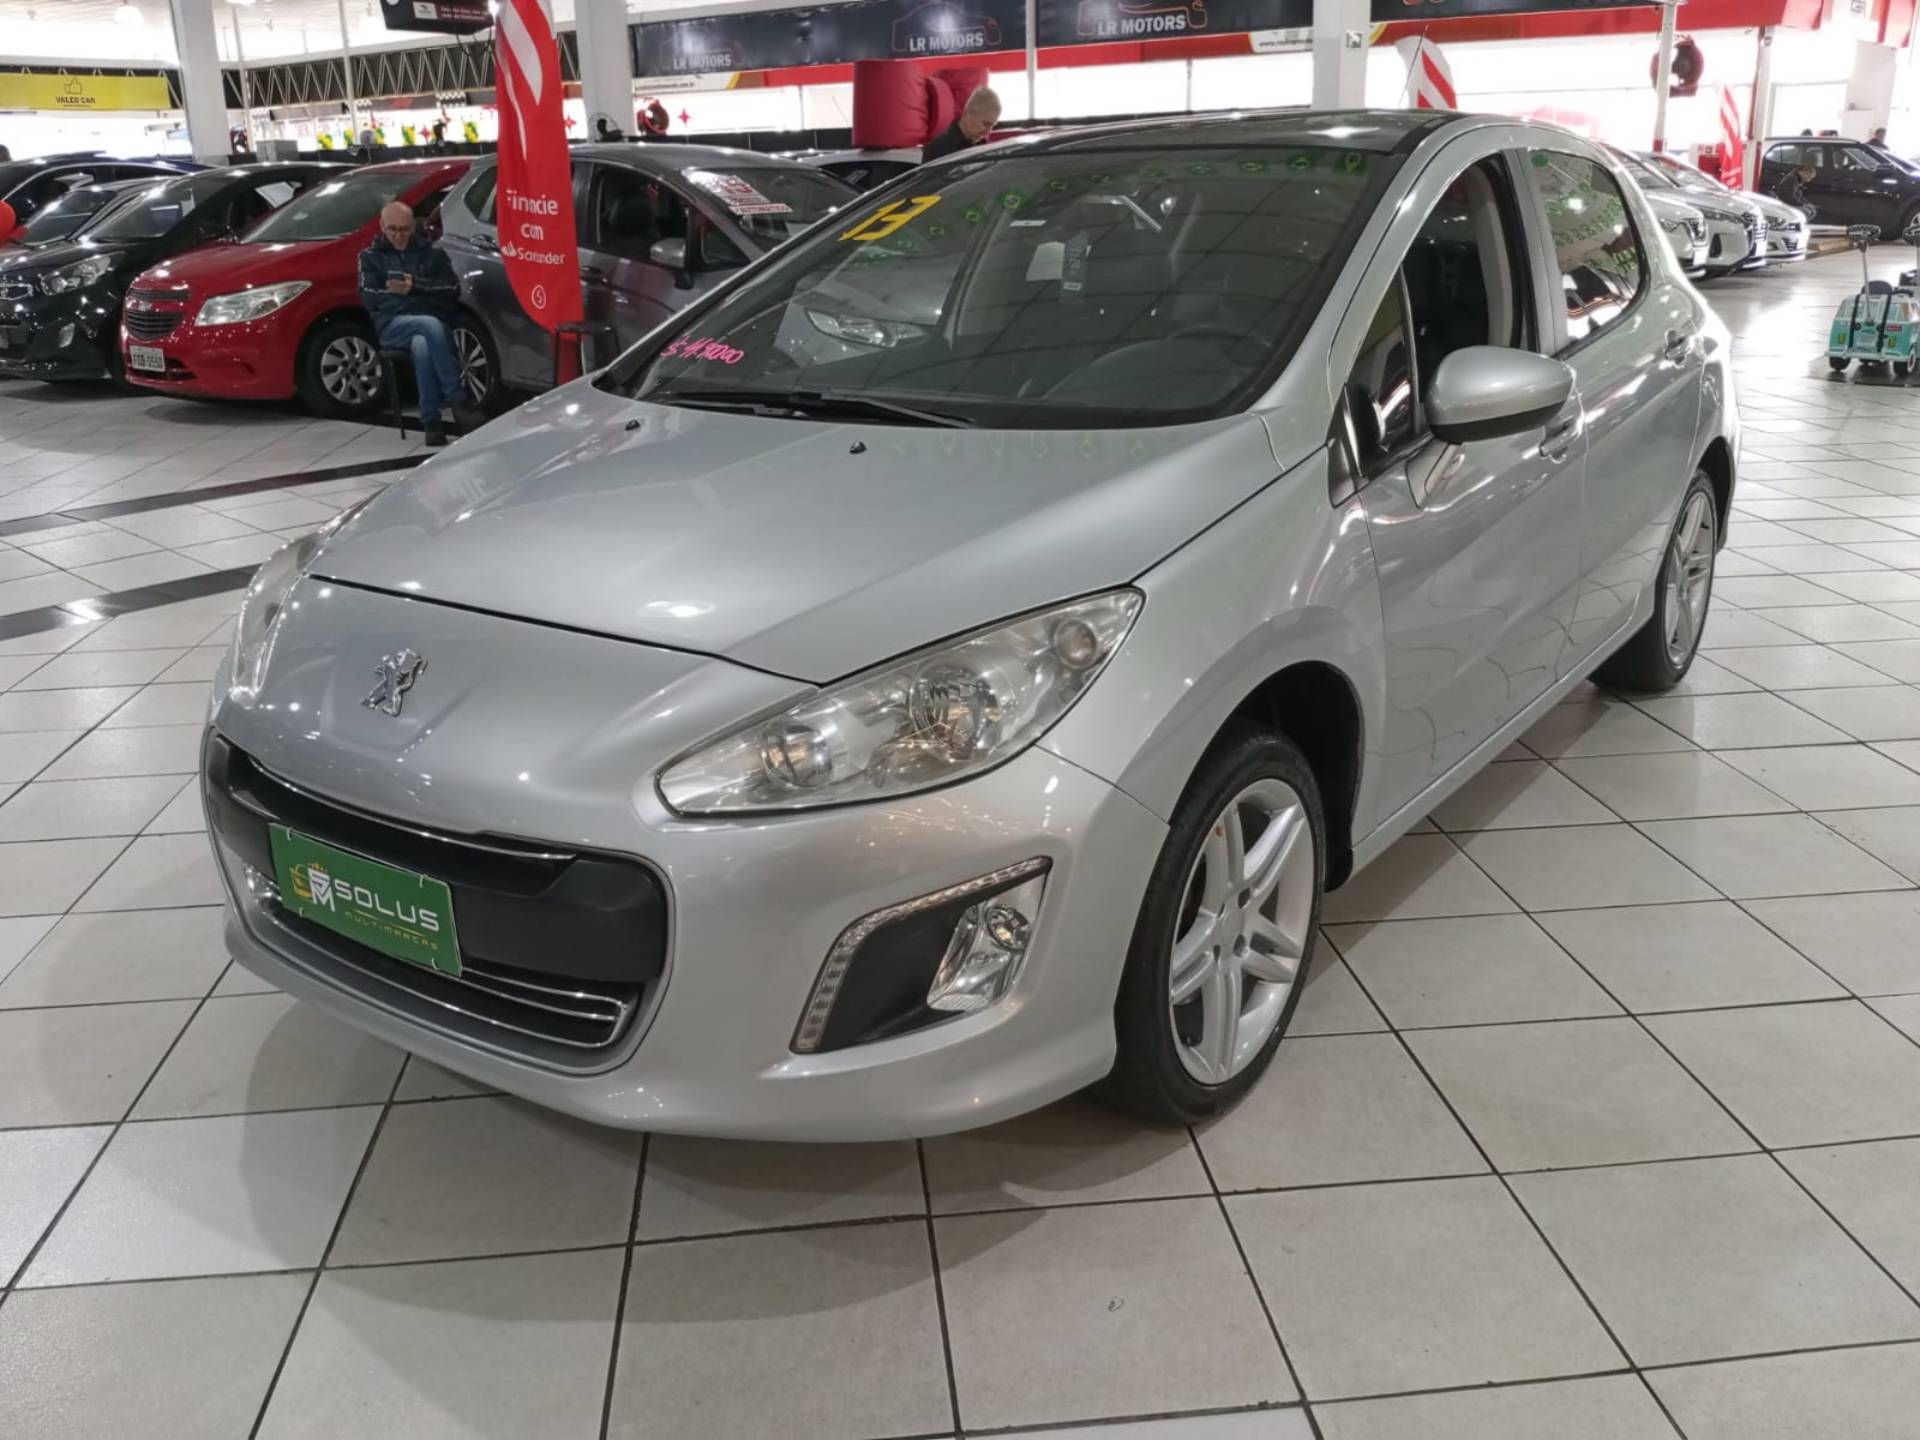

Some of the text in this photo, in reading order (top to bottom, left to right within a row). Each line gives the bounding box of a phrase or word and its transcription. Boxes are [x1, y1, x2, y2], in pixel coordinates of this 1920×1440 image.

[1097, 14, 1187, 36] LR MOTORS
[909, 32, 984, 52] LR MOTORS
[673, 58, 687, 70] LR
[837, 194, 942, 241] 13
[333, 878, 440, 932] SOLUS
